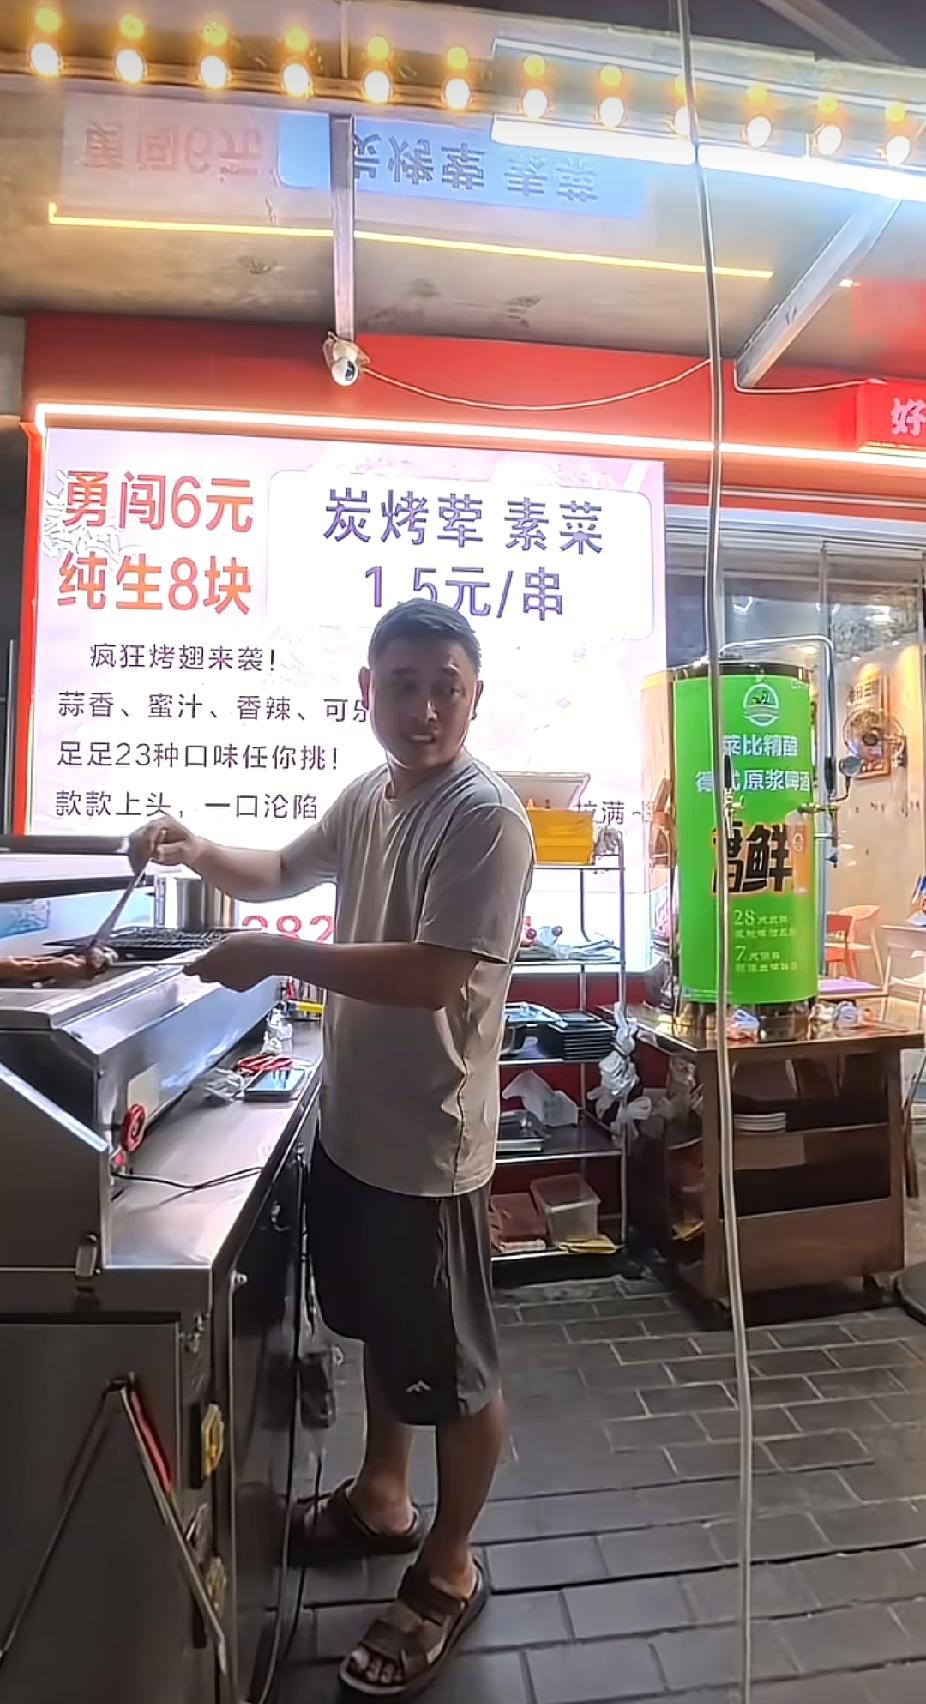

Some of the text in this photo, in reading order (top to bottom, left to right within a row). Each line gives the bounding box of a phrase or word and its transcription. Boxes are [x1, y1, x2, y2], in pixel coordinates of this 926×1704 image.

[891, 398, 926, 436] 好
[62, 470, 253, 531] 勇闯6元
[323, 487, 603, 555] 炭烤荤 素菜
[58, 550, 251, 615] 纯生8块
[365, 566, 563, 621] 15元/串
[90, 643, 276, 671] 疯狂烤翅来袭！
[56, 741, 338, 770] 足足23种口味任你挑！
